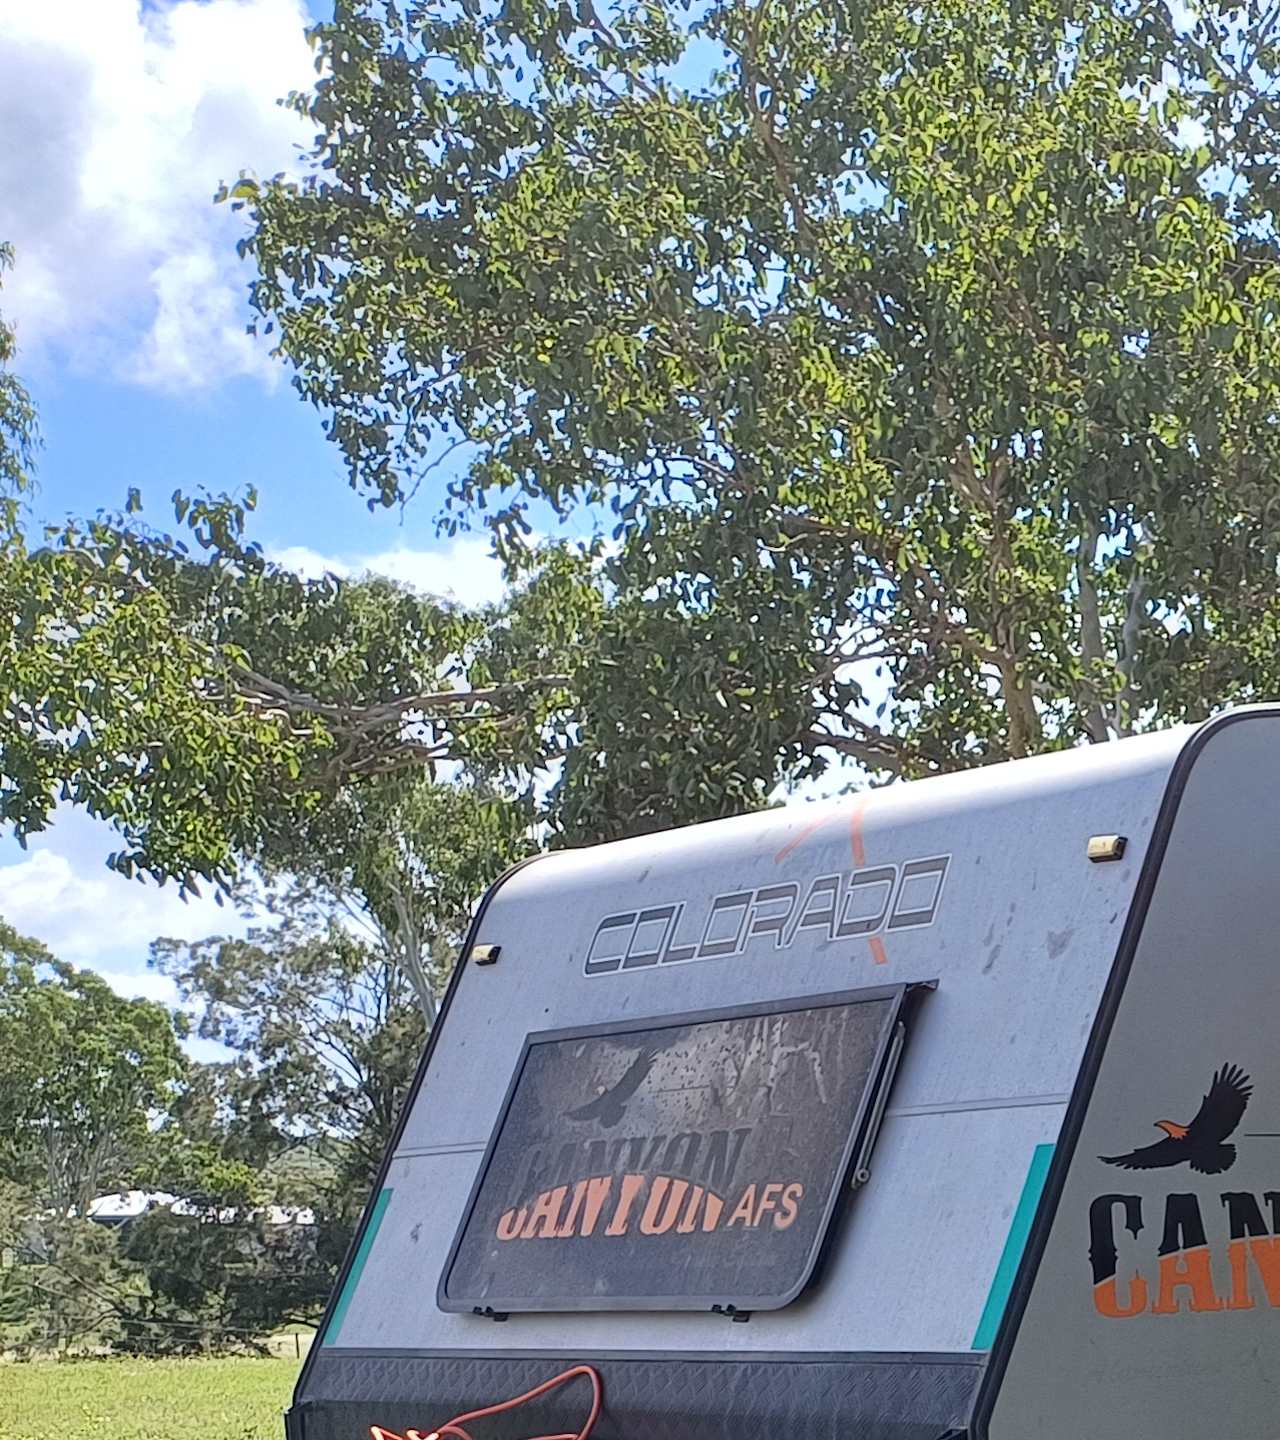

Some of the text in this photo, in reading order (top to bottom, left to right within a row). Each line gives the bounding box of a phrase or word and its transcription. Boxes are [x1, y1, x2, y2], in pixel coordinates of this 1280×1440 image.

[585, 853, 951, 977] COLORADO
[496, 1128, 803, 1241] CANYON AFS
